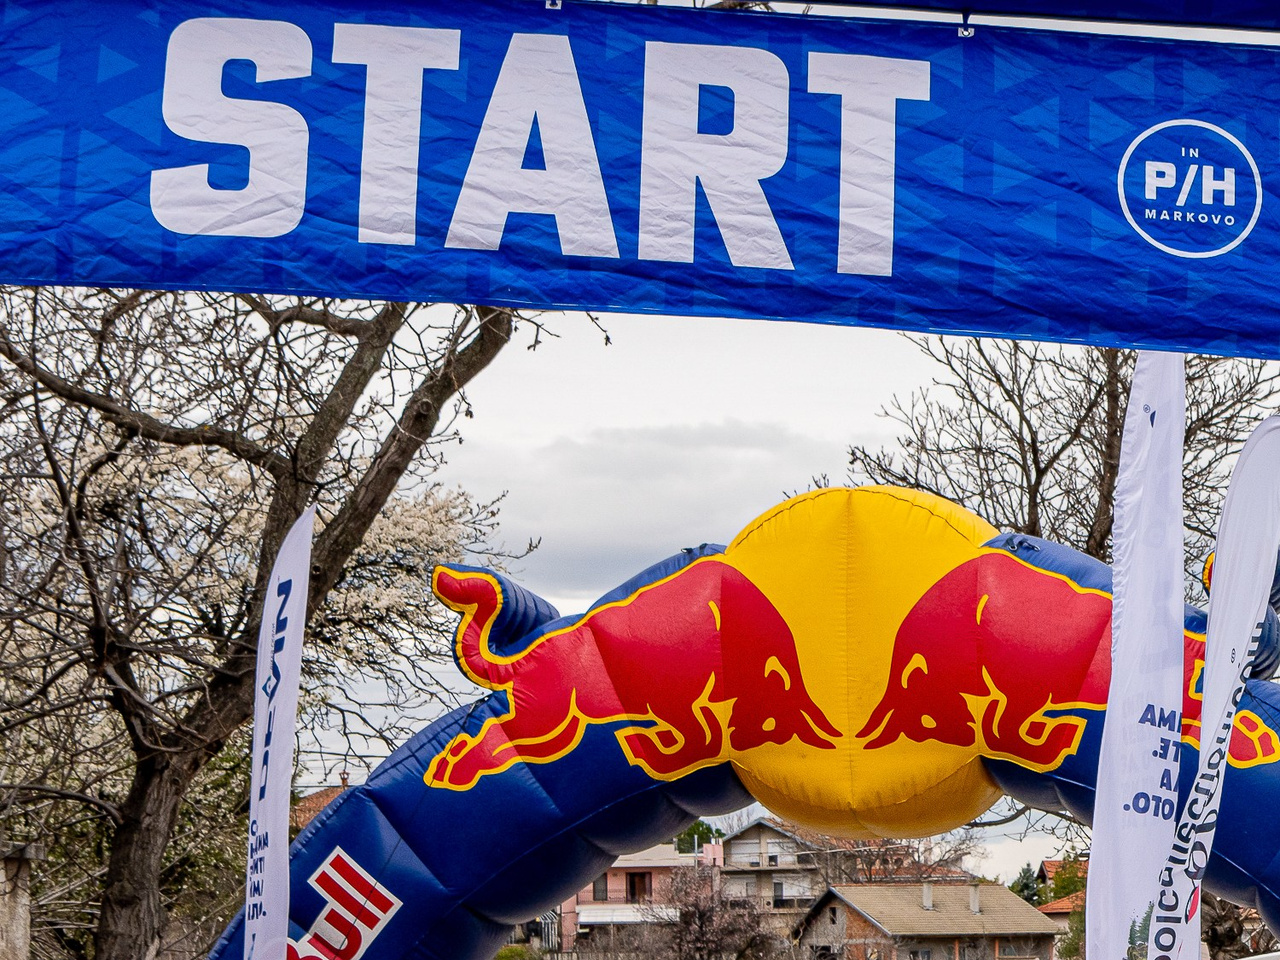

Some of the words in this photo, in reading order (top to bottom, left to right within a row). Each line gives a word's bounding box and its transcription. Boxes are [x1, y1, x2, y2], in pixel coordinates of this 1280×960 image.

[150, 17, 930, 277] START
[1182, 148, 1199, 157] IN
[1144, 160, 1236, 206] P/H
[1144, 208, 1235, 226] MARKOVO
